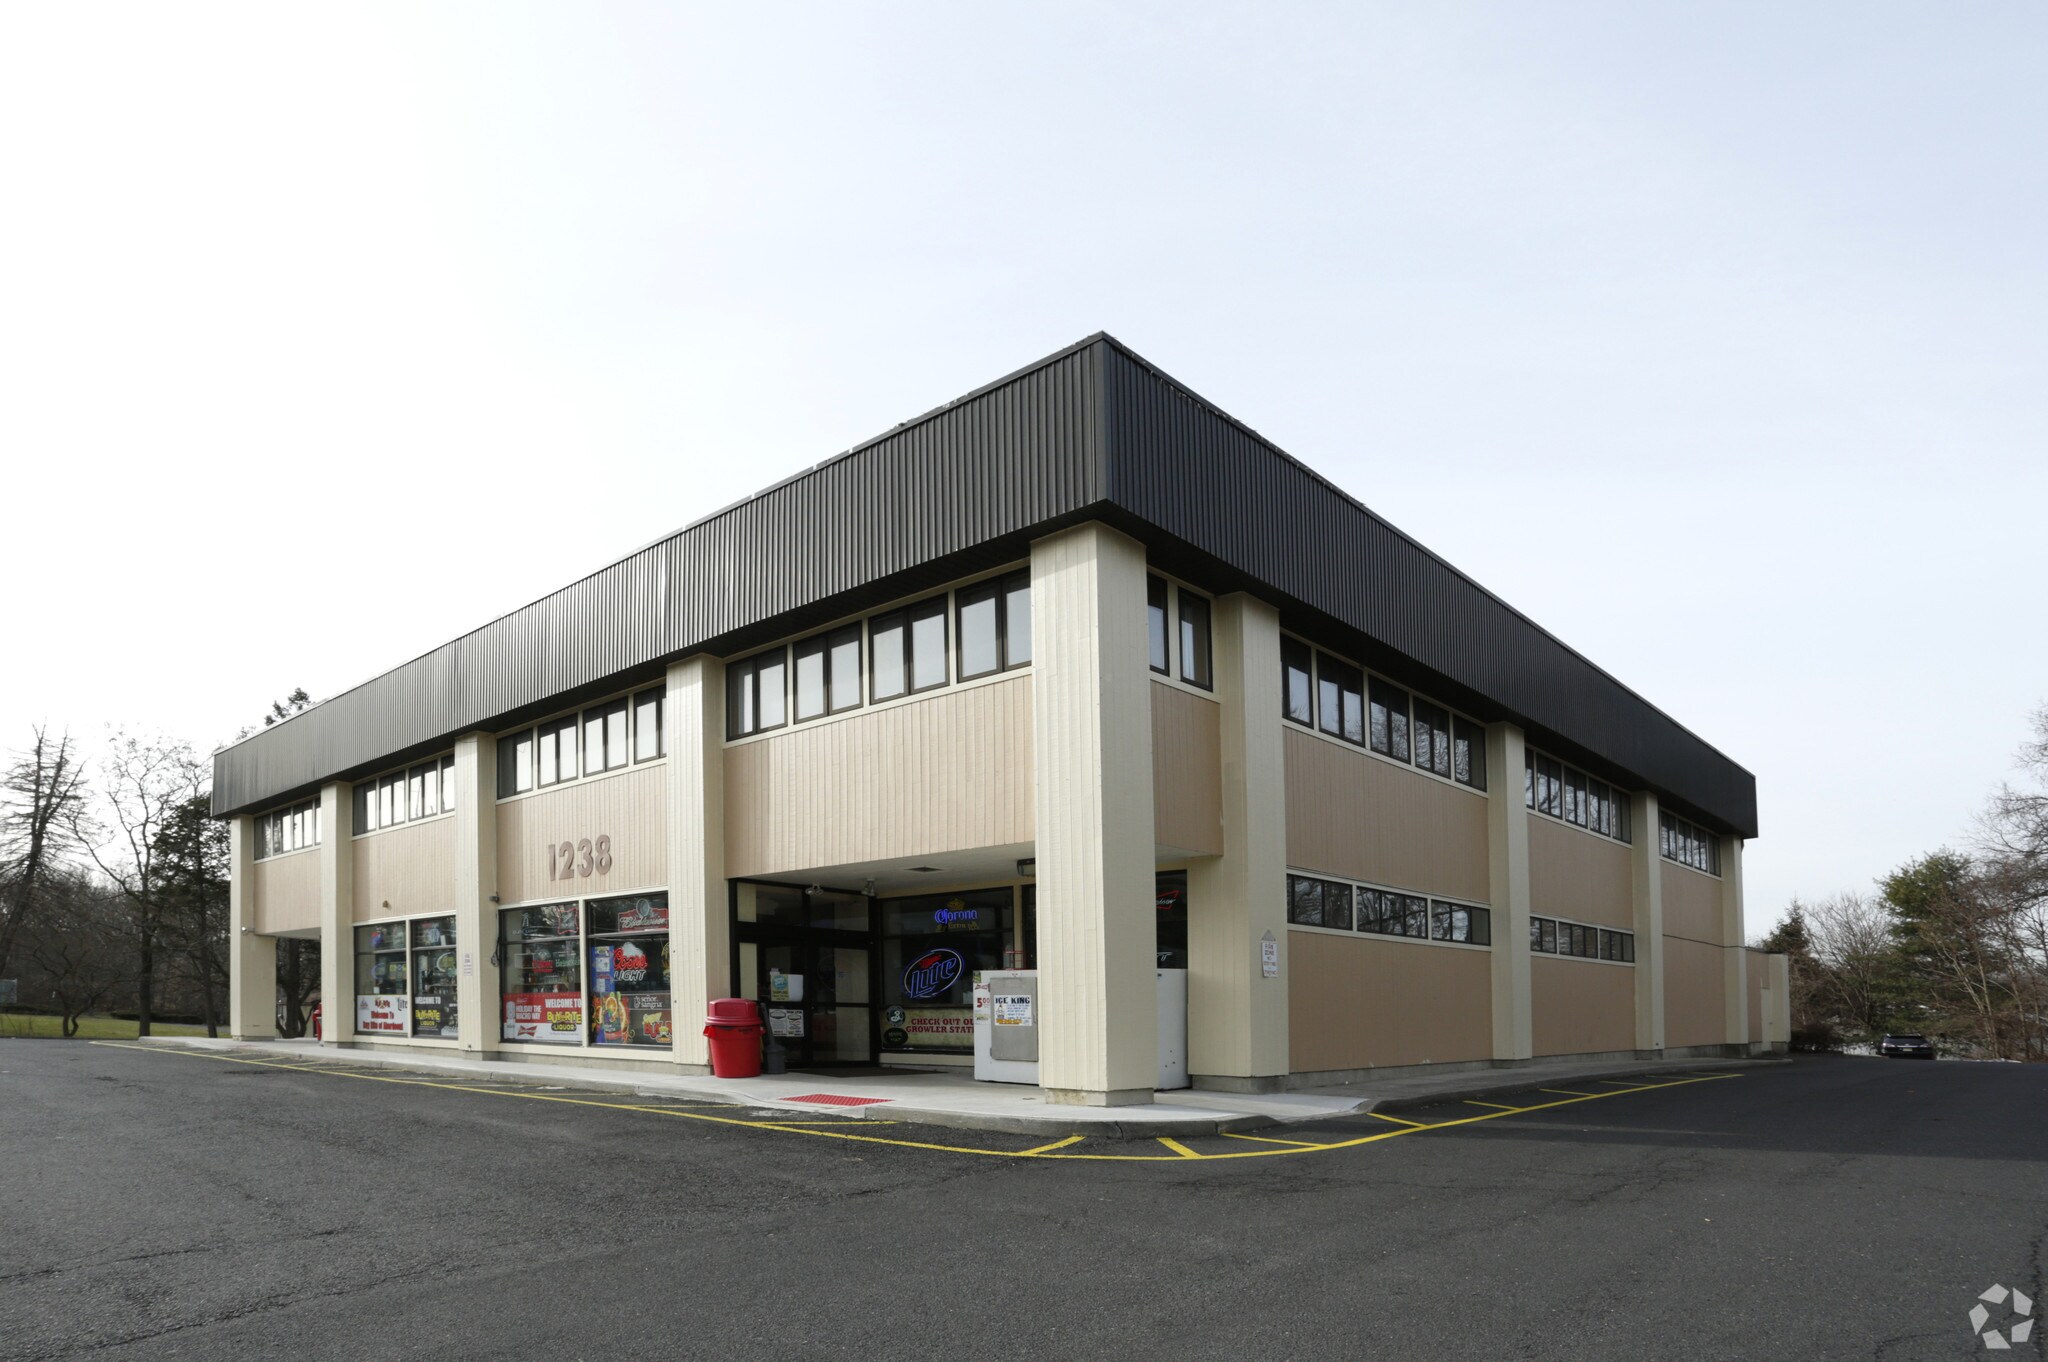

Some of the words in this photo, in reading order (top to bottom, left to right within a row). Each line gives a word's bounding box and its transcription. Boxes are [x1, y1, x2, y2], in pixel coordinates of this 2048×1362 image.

[548, 834, 612, 881] 1238
[935, 909, 978, 924] Corona
[613, 947, 648, 970] Coors
[613, 969, 647, 981] LIGHT
[545, 998, 573, 1008] WELCOME
[995, 996, 1008, 1004] ICE
[1011, 996, 1030, 1004] KING
[911, 1018, 940, 1026] CHECK
[942, 1018, 961, 1026] OUT
[963, 1018, 974, 1026] OU
[905, 1025, 947, 1033] GROWLER
[949, 1025, 974, 1034] STATI
